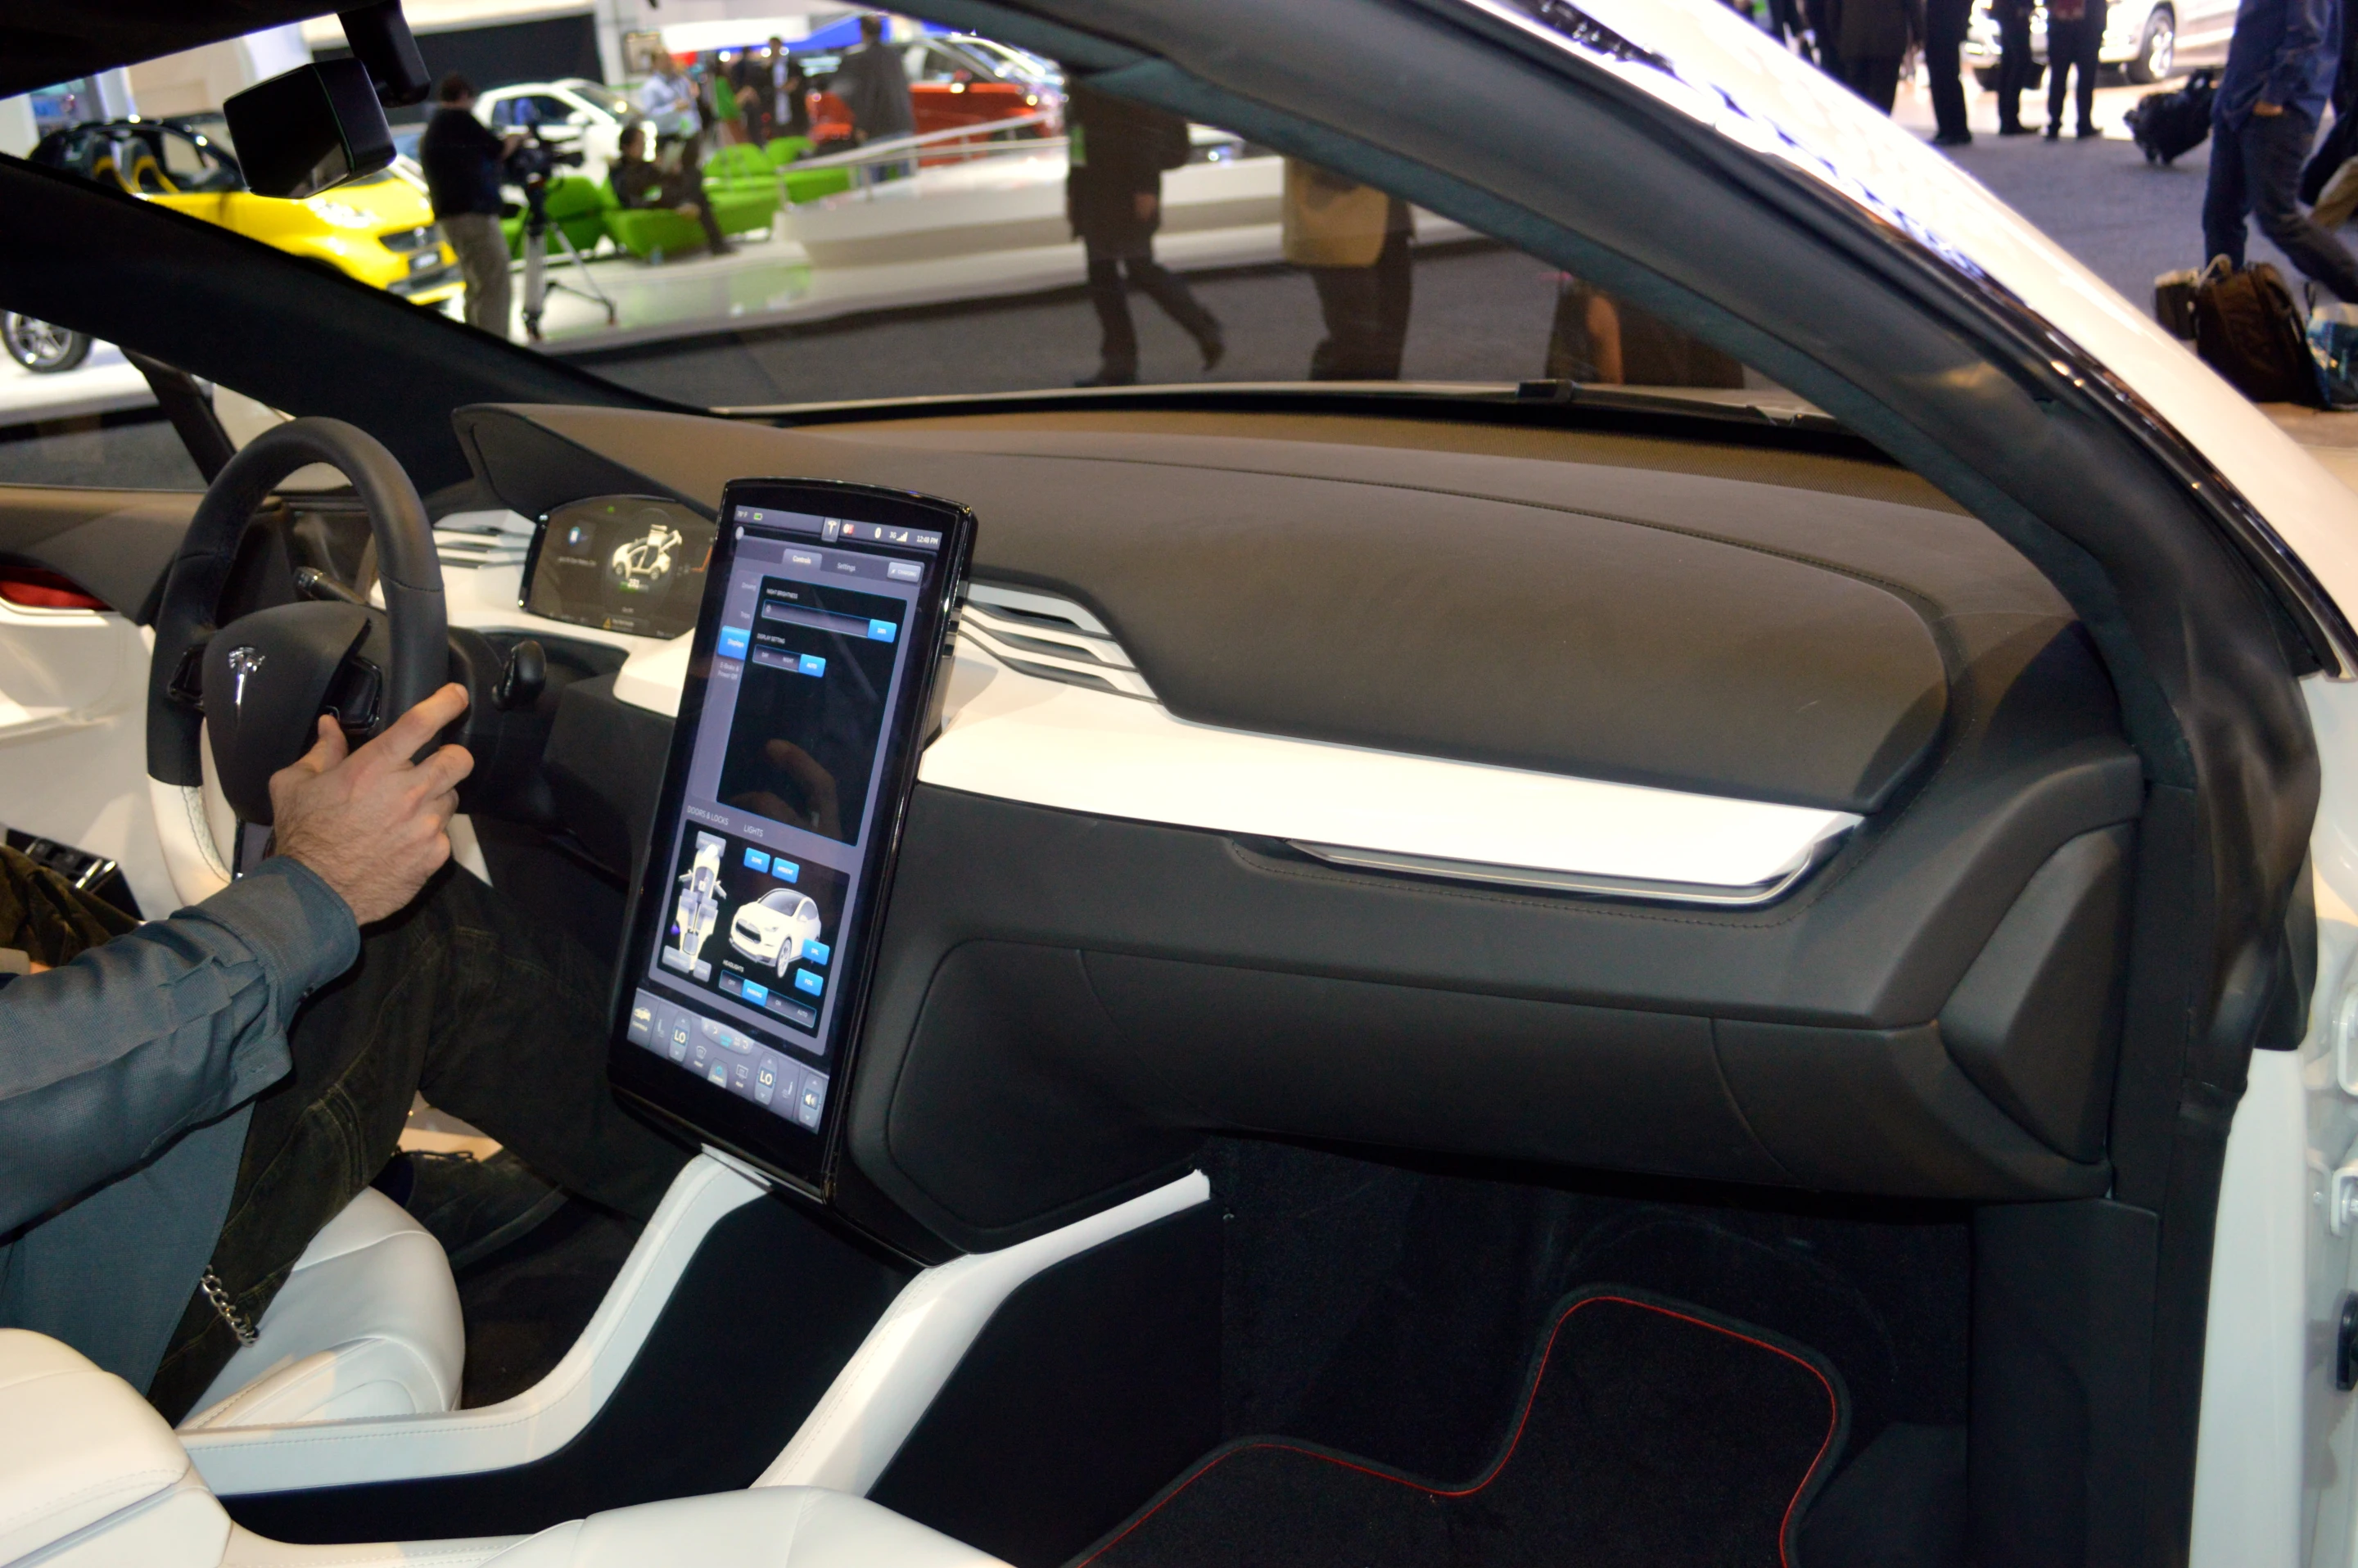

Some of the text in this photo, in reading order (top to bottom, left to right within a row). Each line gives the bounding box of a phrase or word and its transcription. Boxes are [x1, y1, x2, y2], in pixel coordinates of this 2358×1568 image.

[930, 537, 938, 545] PM
[793, 555, 811, 565] Controls
[837, 563, 856, 572] Settings
[806, 662, 817, 670] AUTO
[687, 806, 729, 825] DOORS & LOCKS
[743, 825, 764, 838] LIGHTS
[722, 959, 744, 973] HEADLIGHTS
[728, 978, 736, 987] OFF
[804, 978, 814, 987] FOG
[775, 999, 782, 1007] ON
[797, 1008, 808, 1019] AUTO
[674, 1028, 687, 1045] LO
[759, 1069, 774, 1087] LO
